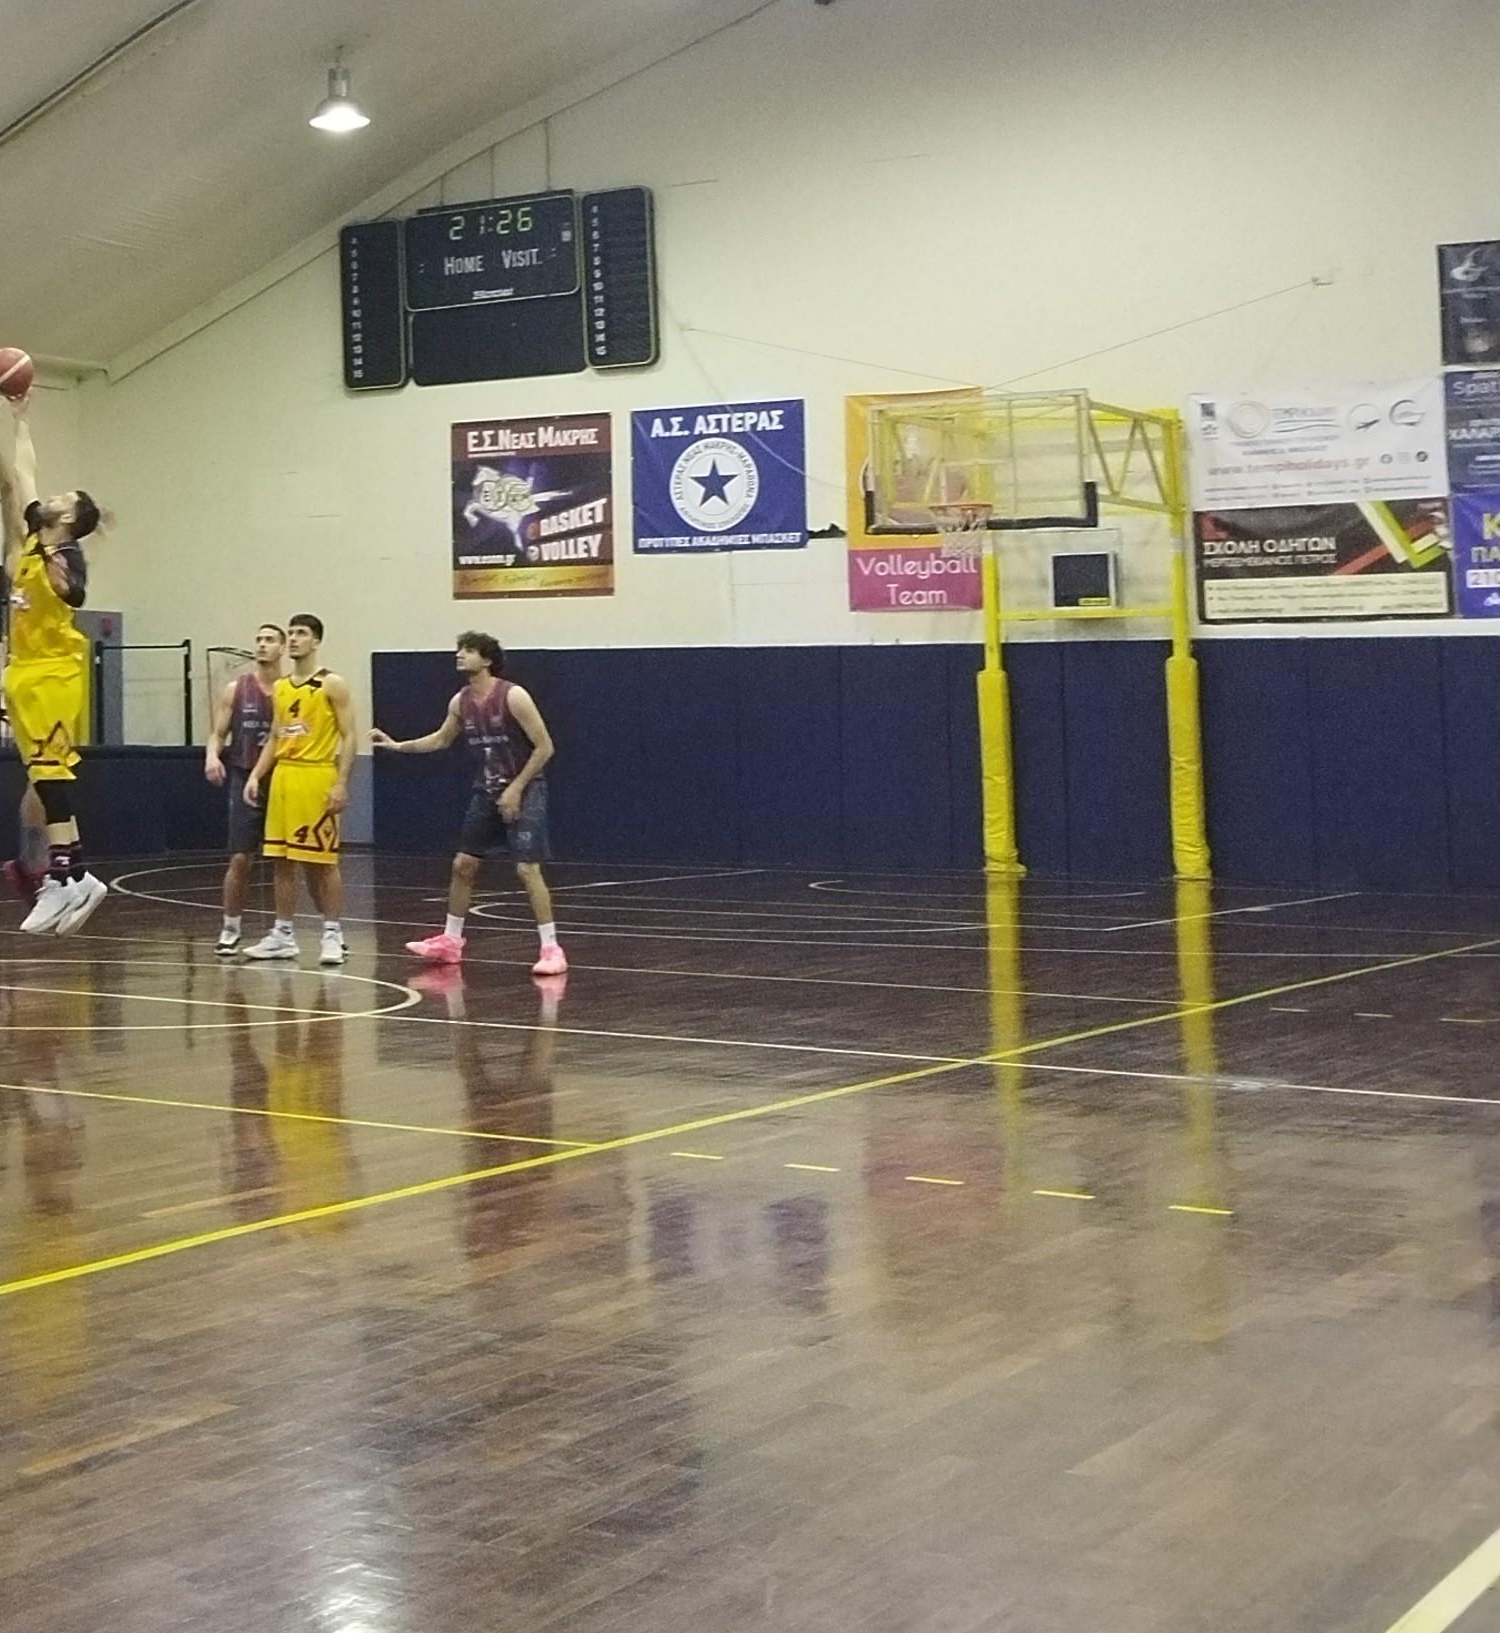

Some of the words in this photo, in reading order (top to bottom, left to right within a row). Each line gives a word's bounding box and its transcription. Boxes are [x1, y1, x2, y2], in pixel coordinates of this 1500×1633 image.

[650, 416, 691, 438] Α.Σ.
[693, 410, 785, 435] ΑΣΤΕΡΑΣ
[539, 498, 608, 537] BASKET
[540, 533, 603, 561] VOLLEY
[1202, 540, 1260, 555] ΣΧΟΛΗ
[1263, 537, 1337, 553] ΟΔΗΓΩΝ
[856, 552, 977, 580] Volleyball
[886, 584, 948, 605] Team
[289, 698, 301, 718] 4
[293, 825, 309, 843] 4
